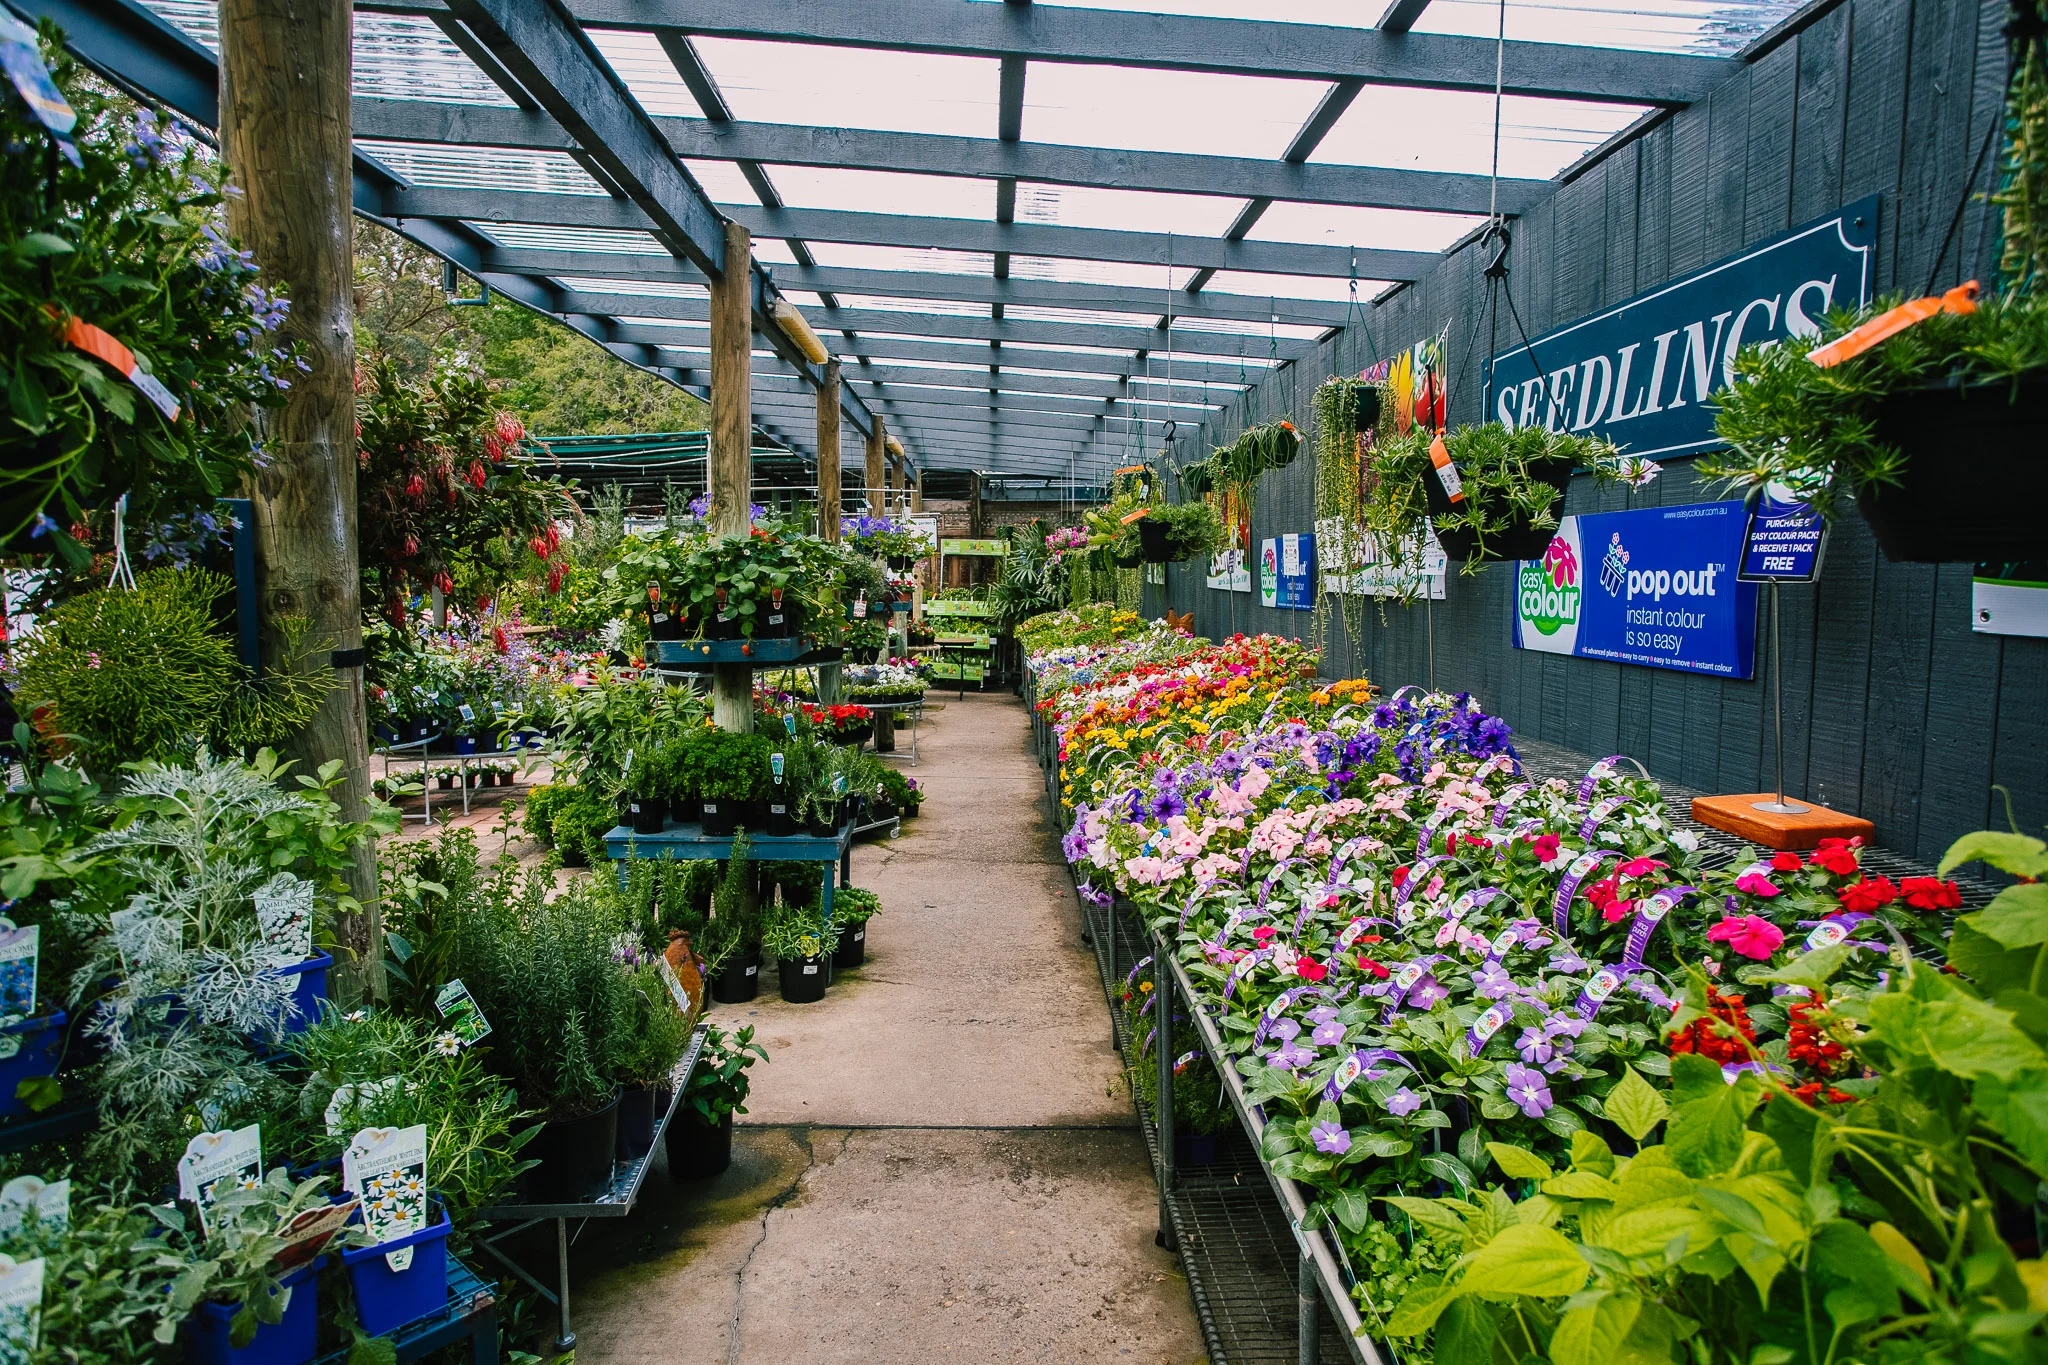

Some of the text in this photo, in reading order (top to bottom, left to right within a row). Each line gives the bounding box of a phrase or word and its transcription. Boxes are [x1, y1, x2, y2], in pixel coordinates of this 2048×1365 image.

[1498, 274, 1836, 433] SEEDLINGS
[1664, 506, 1727, 519] www.easycolour.com.au
[1765, 519, 1804, 528] PURCHASE
[1751, 532, 1768, 541] EASY
[1768, 531, 1798, 541] COLOUR
[1752, 544, 1758, 553] &
[1758, 544, 1788, 553] RECEIVE
[1793, 543, 1814, 552] PACK
[1762, 556, 1795, 571] FREE
[1522, 571, 1545, 591] easy
[1627, 570, 1670, 601] pop
[1673, 563, 1716, 596] out
[1522, 584, 1578, 619] colour
[1626, 605, 1705, 629] instant colour
[1626, 627, 1682, 655] is so easy
[1588, 648, 1606, 656] advanced
[1606, 650, 1619, 658] plants
[1622, 653, 1632, 661] easy
[1638, 655, 1651, 664] carry
[1654, 656, 1664, 666] easy
[1671, 659, 1690, 668] remove
[1695, 660, 1714, 671] instant
[1715, 662, 1733, 673] colour
[1631, 925, 1647, 939] punch
[1636, 920, 1648, 931] vinca
[1578, 1001, 1592, 1013] vinca
